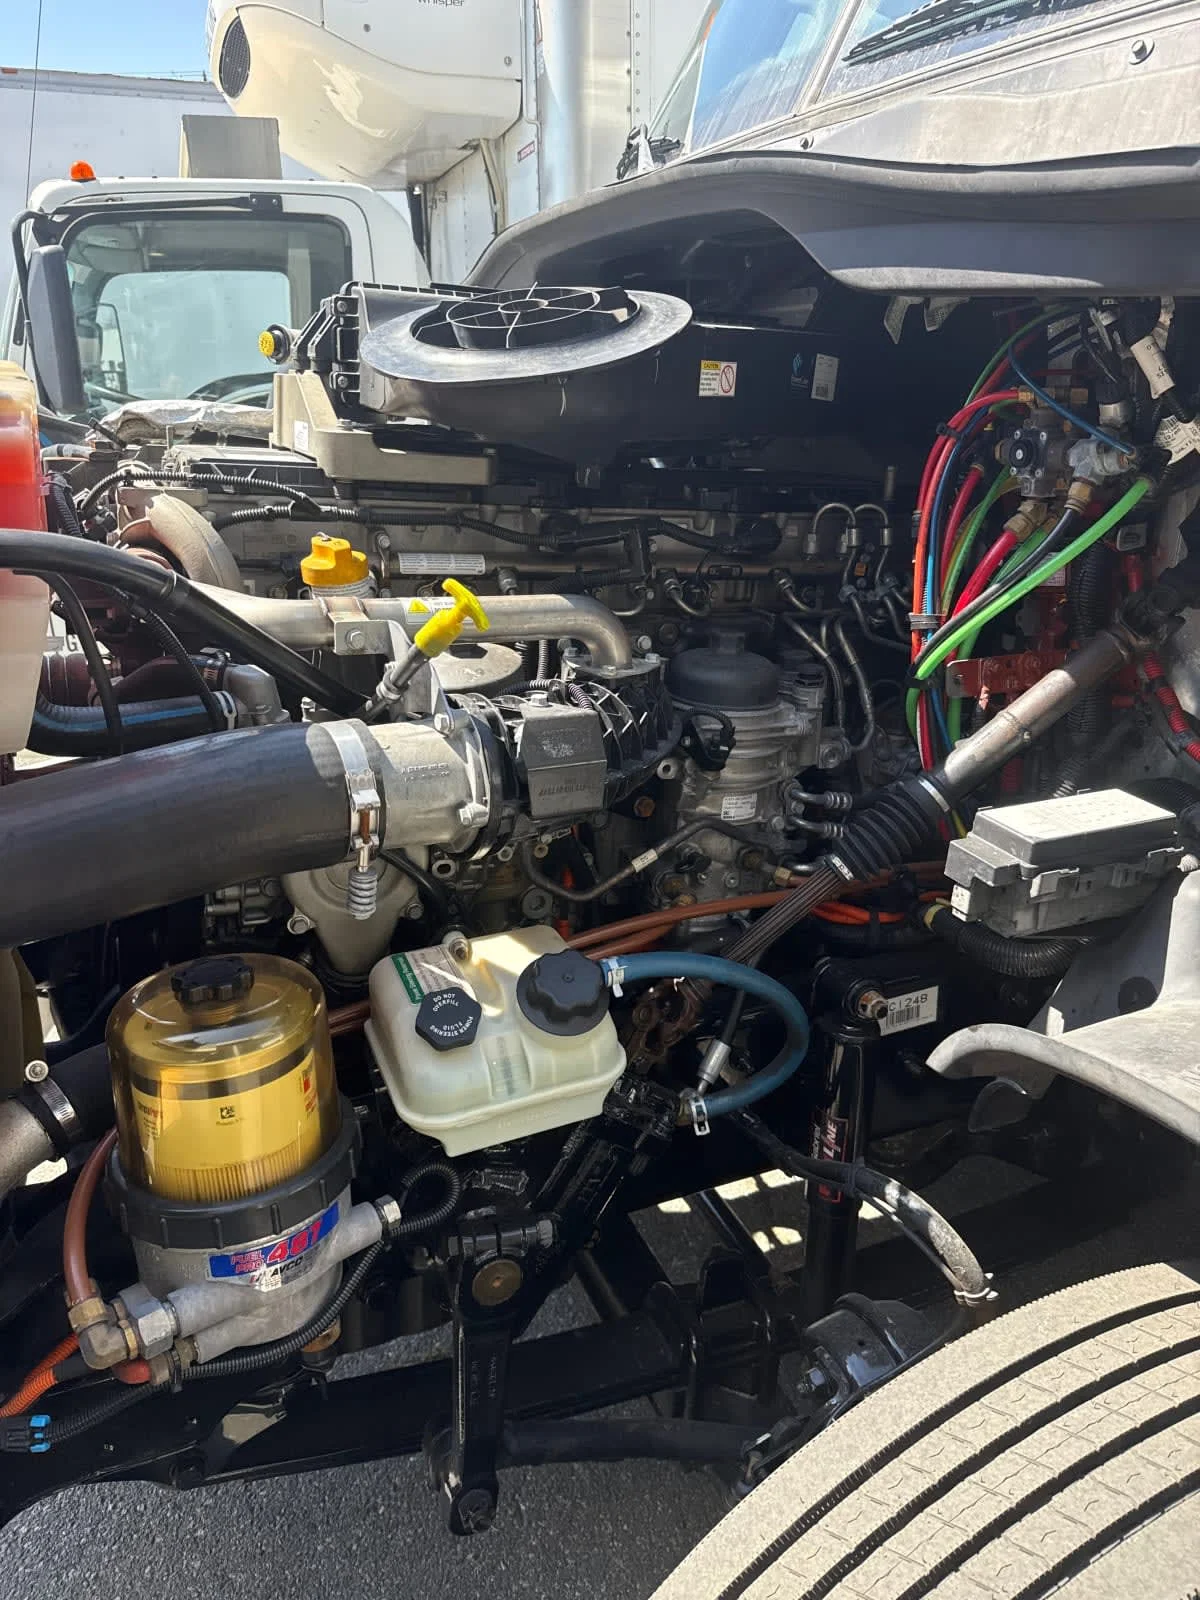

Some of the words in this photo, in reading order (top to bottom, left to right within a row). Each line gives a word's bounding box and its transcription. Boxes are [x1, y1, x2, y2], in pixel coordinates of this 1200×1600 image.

[432, 995, 442, 1003] DO
[432, 999, 460, 1012] OVERFILL
[429, 1025, 459, 1037] STEERING
[442, 1021, 463, 1031] FLUID
[458, 1016, 474, 1034] POWER
[230, 1250, 264, 1265] FUEL
[235, 1259, 264, 1274] PRO
